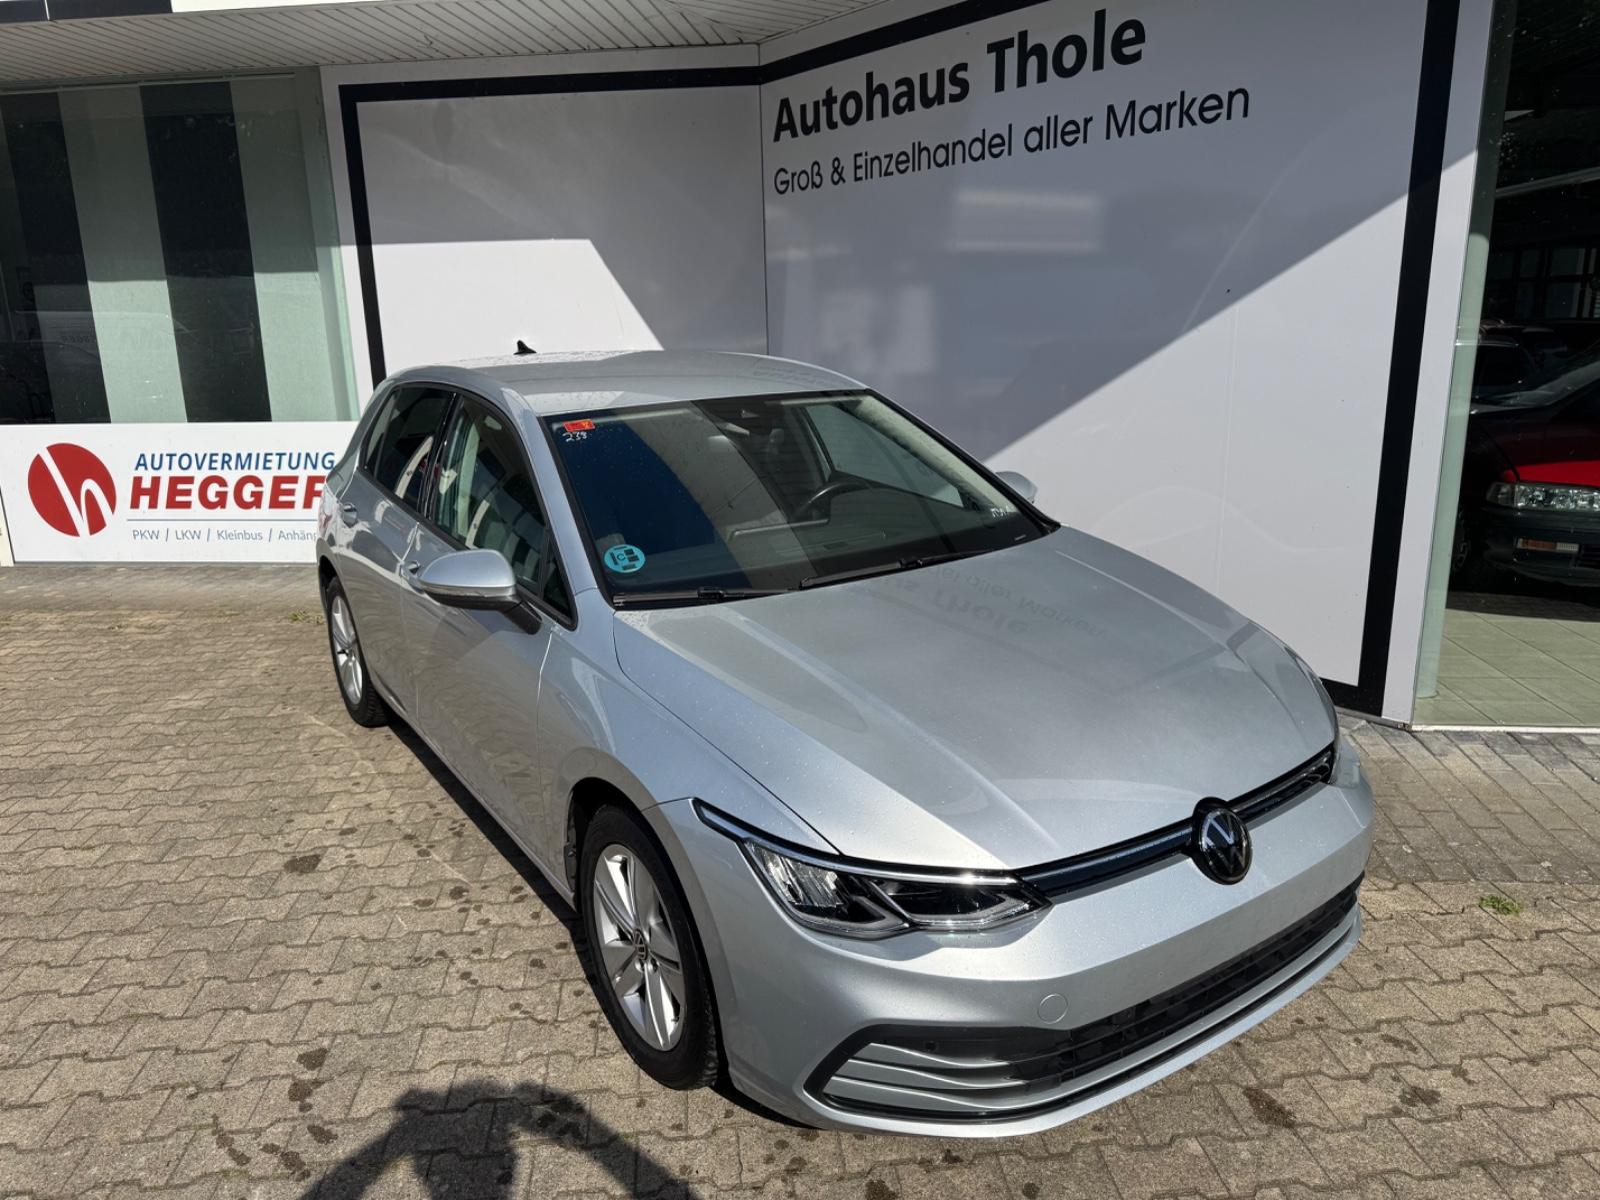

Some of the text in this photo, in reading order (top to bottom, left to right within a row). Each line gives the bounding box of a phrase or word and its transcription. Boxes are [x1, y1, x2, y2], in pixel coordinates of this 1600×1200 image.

[773, 8, 1147, 143] Autohaus Thole
[773, 87, 1251, 196] Groß & Einzelhandel aller Marken
[134, 452, 336, 471] AUTOVERMIETUNG
[132, 529, 160, 541] PKW
[175, 529, 202, 541] LKW
[216, 528, 264, 541] Kleinbus
